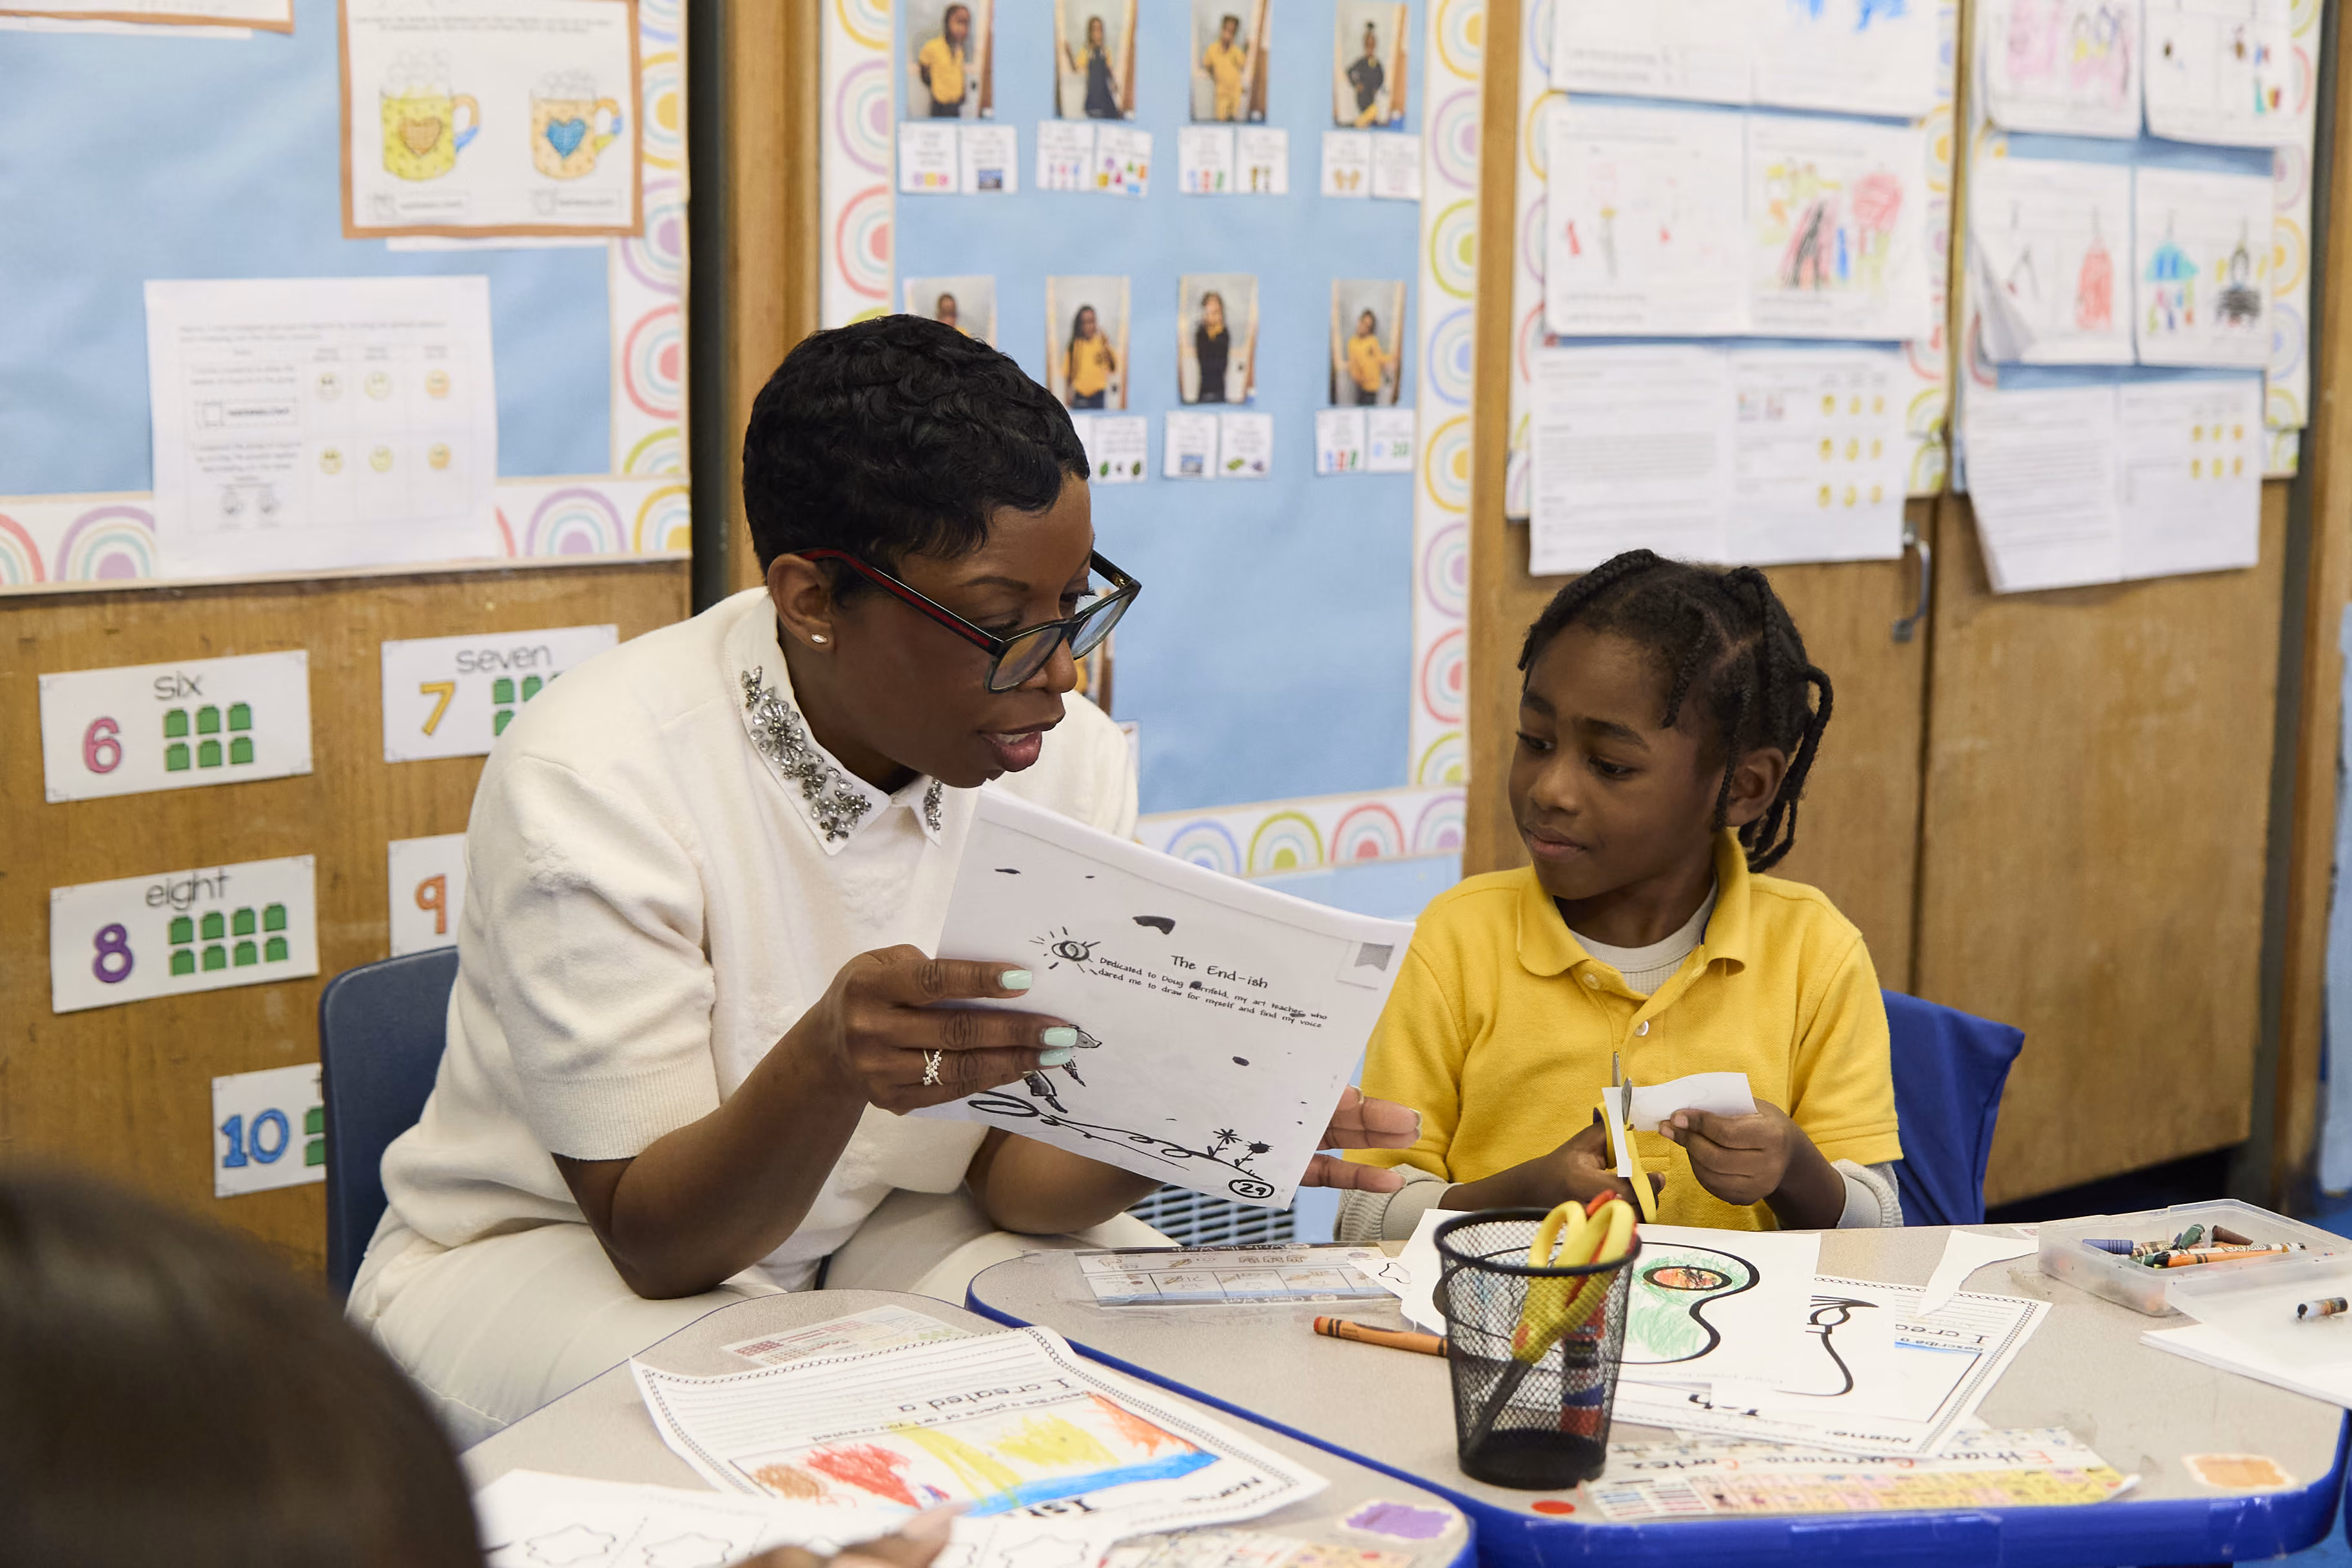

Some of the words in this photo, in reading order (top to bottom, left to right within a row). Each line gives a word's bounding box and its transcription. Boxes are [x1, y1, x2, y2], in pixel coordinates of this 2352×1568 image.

[456, 644, 552, 674] seven
[154, 671, 204, 701] six
[420, 681, 456, 736] 7
[83, 717, 123, 774] 6
[145, 867, 230, 911] eight
[414, 873, 447, 934] 9
[93, 923, 134, 983] 8
[1171, 954, 1197, 970] The
[1207, 965, 1268, 989] End-ish
[1098, 968, 1124, 981] dared
[1129, 978, 1142, 986] me
[1161, 985, 1183, 996] draw
[1187, 992, 1201, 1001] for
[1205, 998, 1235, 1009] myself
[1238, 1006, 1255, 1014] and
[1260, 1009, 1278, 1019] find
[1282, 1016, 1296, 1025] my
[1299, 1020, 1323, 1028] voice
[1100, 957, 1143, 976] Dedicated
[1161, 974, 1184, 989] Doug
[1234, 994, 1248, 1004] my
[1271, 1003, 1304, 1014] teacher
[1310, 1012, 1328, 1020] who
[220, 1108, 290, 1168] 10
[1239, 1183, 1267, 1196] 29
[1915, 1339, 1984, 1352] Describe
[898, 1404, 917, 1412] a
[927, 1383, 1042, 1411] created
